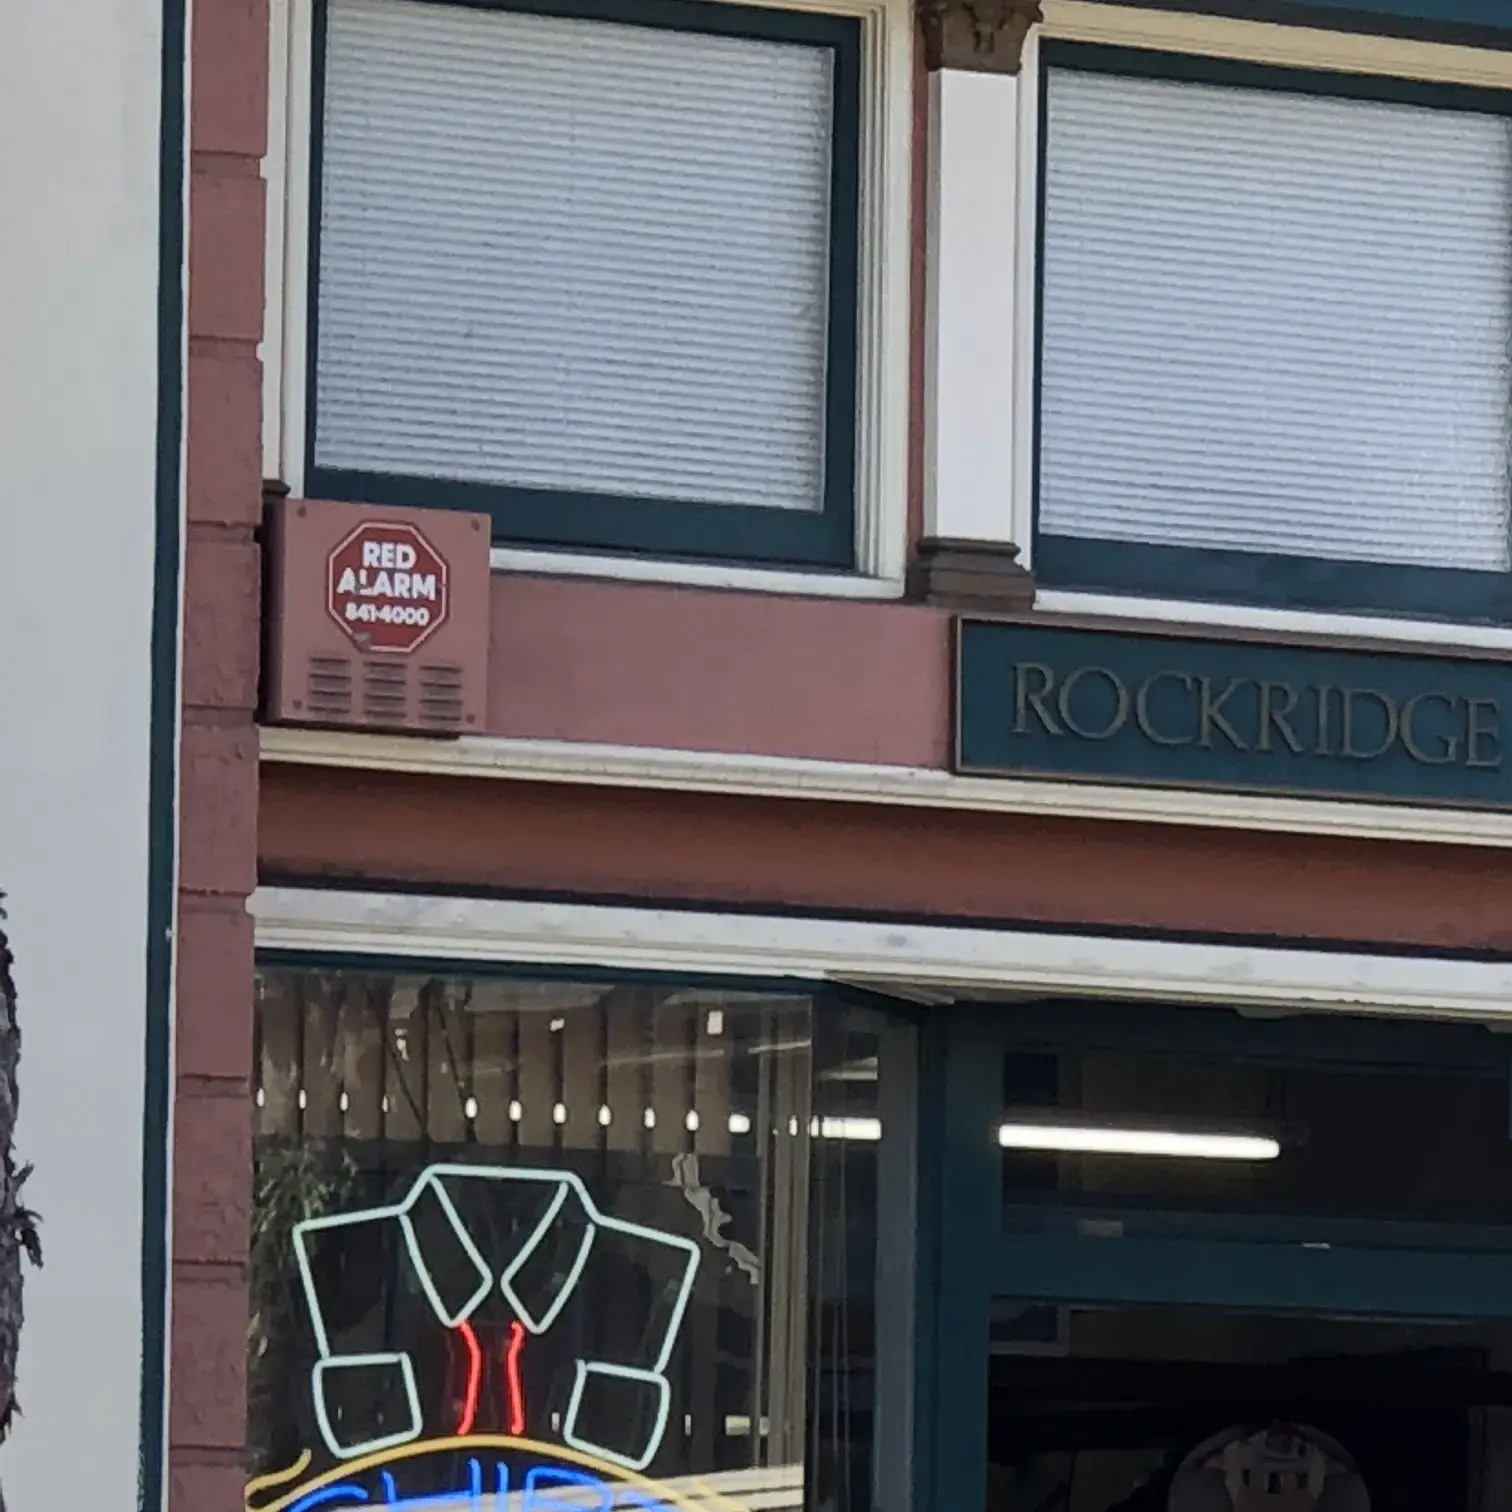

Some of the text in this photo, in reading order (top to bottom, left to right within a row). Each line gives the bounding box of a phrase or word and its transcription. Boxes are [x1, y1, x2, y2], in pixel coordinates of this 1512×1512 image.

[363, 541, 417, 570] RED
[336, 566, 436, 600] ALARM
[1013, 662, 1501, 767] ROCKRIDGE
